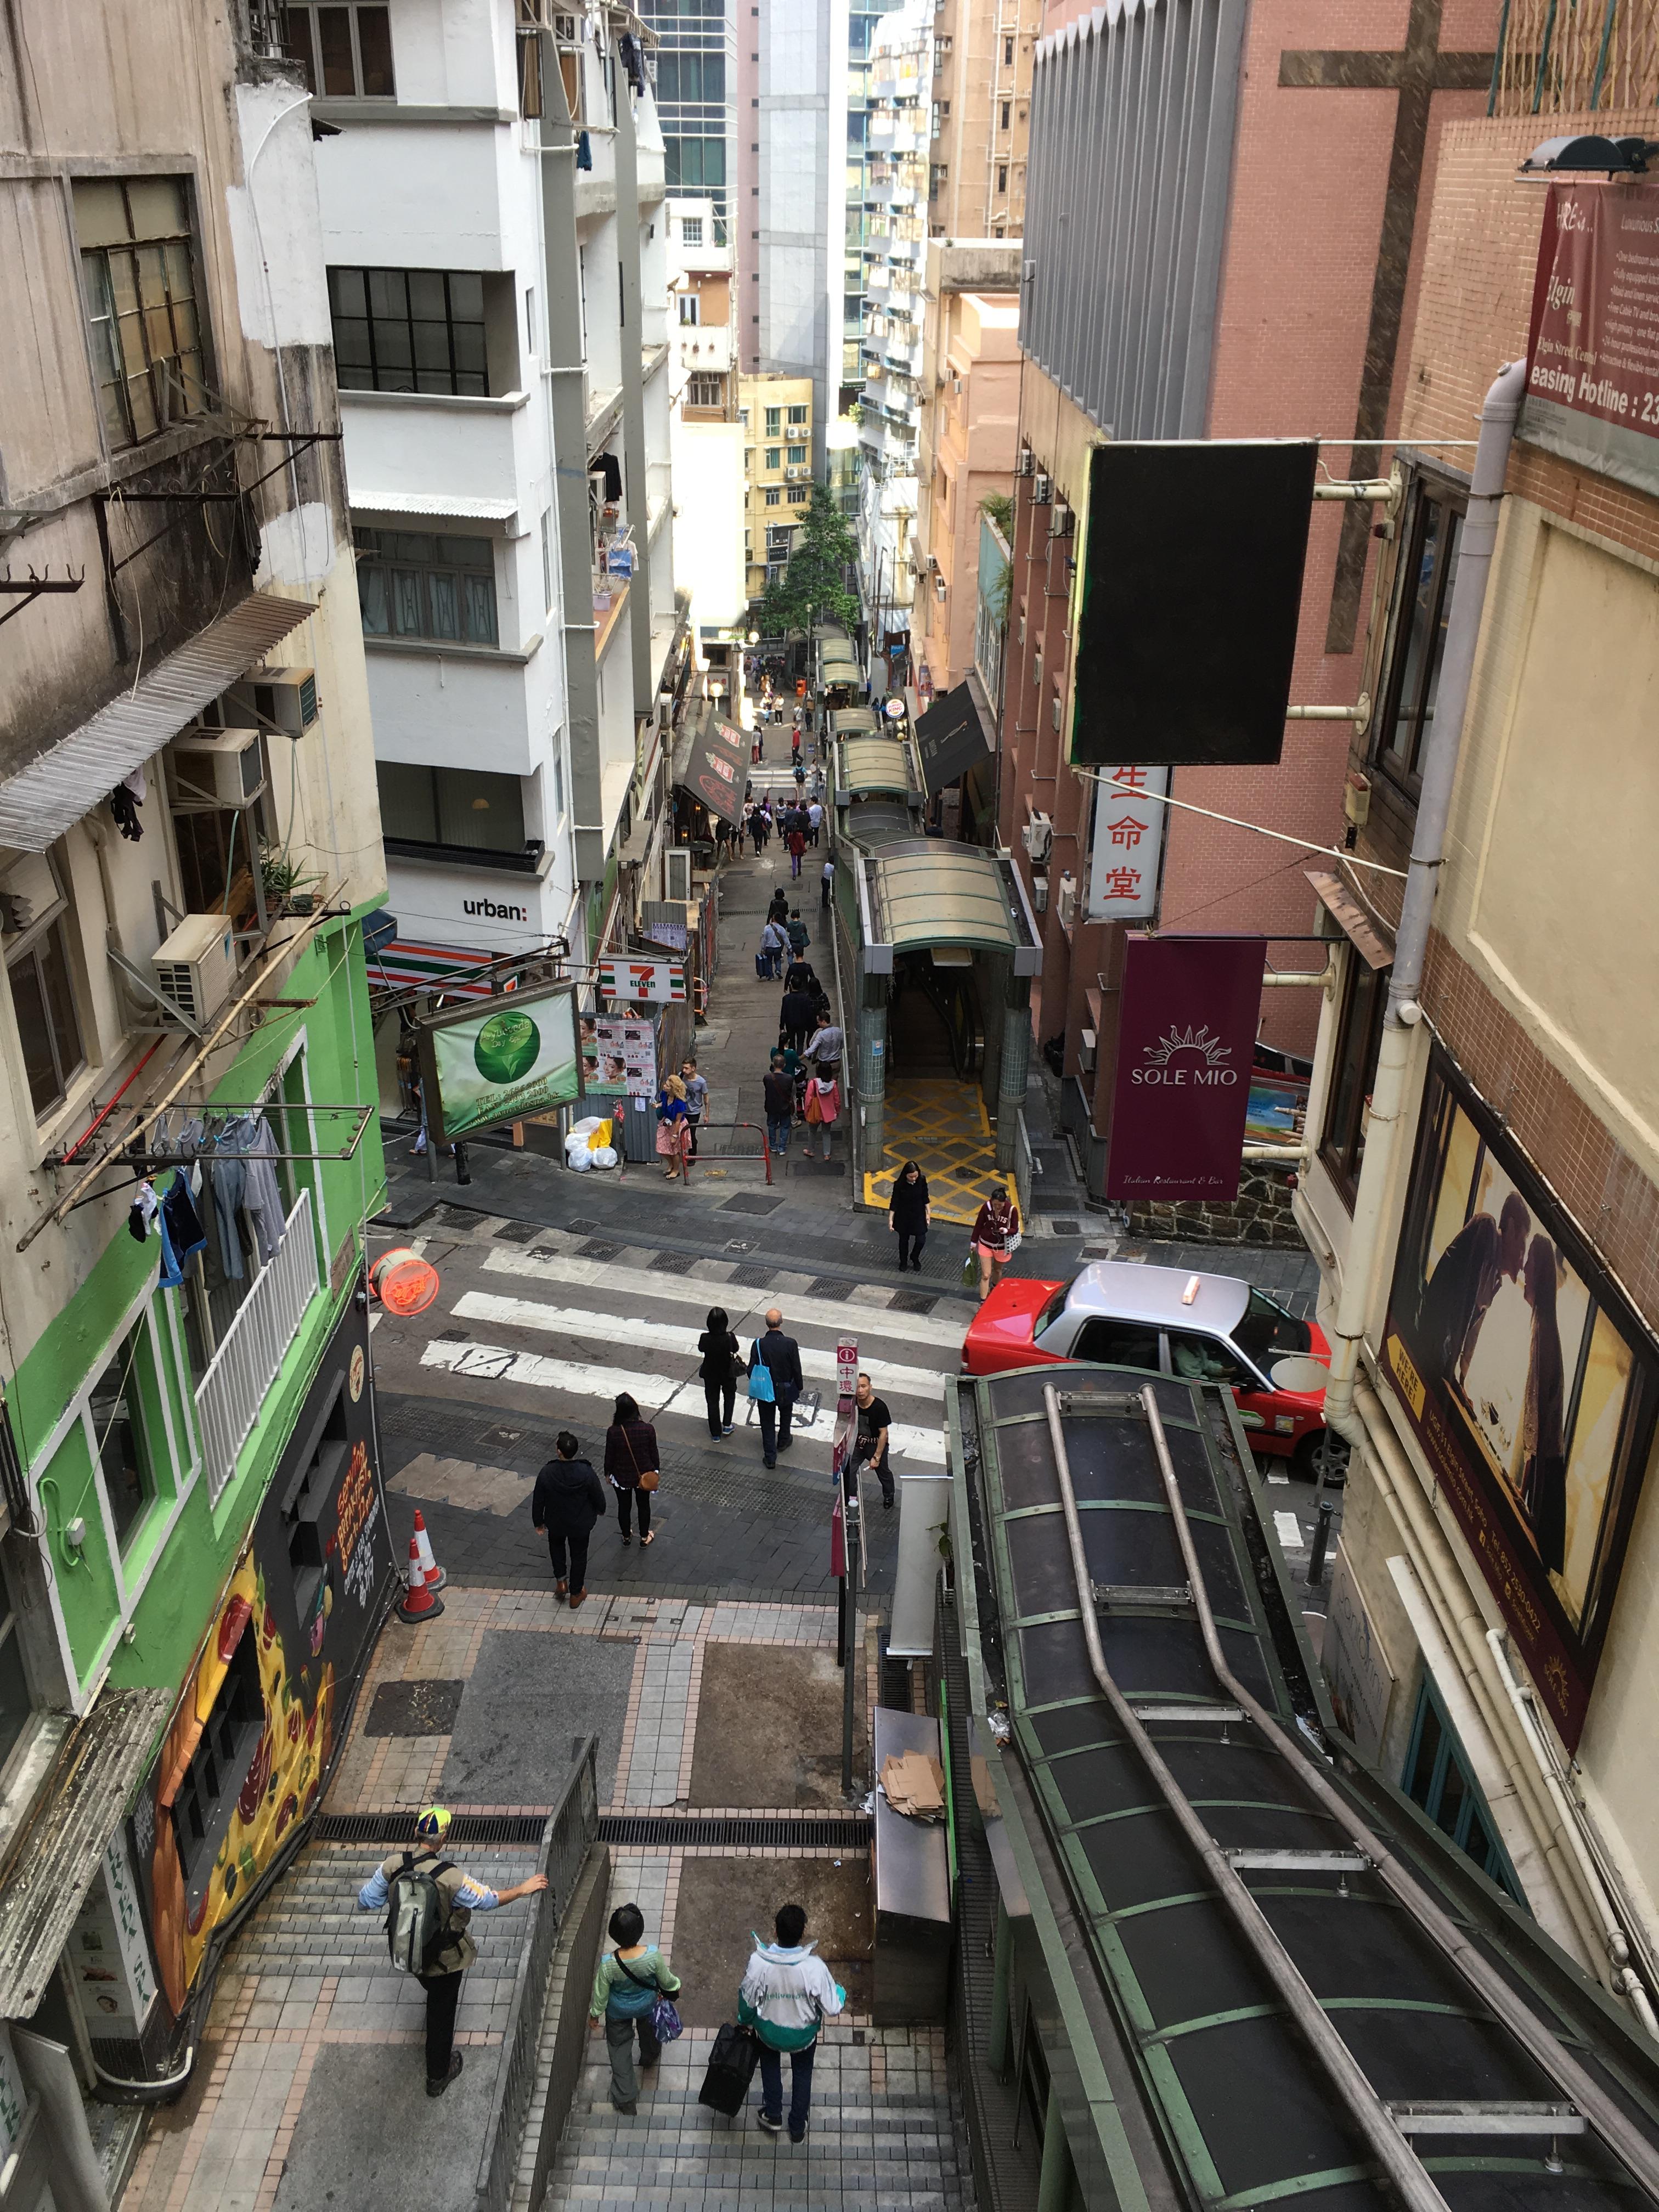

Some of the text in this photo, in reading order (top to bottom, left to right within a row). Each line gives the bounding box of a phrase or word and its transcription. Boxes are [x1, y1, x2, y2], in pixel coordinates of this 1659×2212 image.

[1531, 365, 1576, 402] easing
[1578, 372, 1628, 414] Hotline
[629, 965, 655, 998] 7
[1131, 1069, 1238, 1086] SOLE MIO
[1123, 1175, 1150, 1185] Italian
[1153, 1176, 1196, 1185] Restaurant
[1209, 1176, 1223, 1185] Bar
[839, 1366, 854, 1392] 中環
[1396, 1363, 1416, 1405] HERE!
[1400, 1348, 1419, 1393] WE'RE
[337, 1441, 365, 1515] Serving
